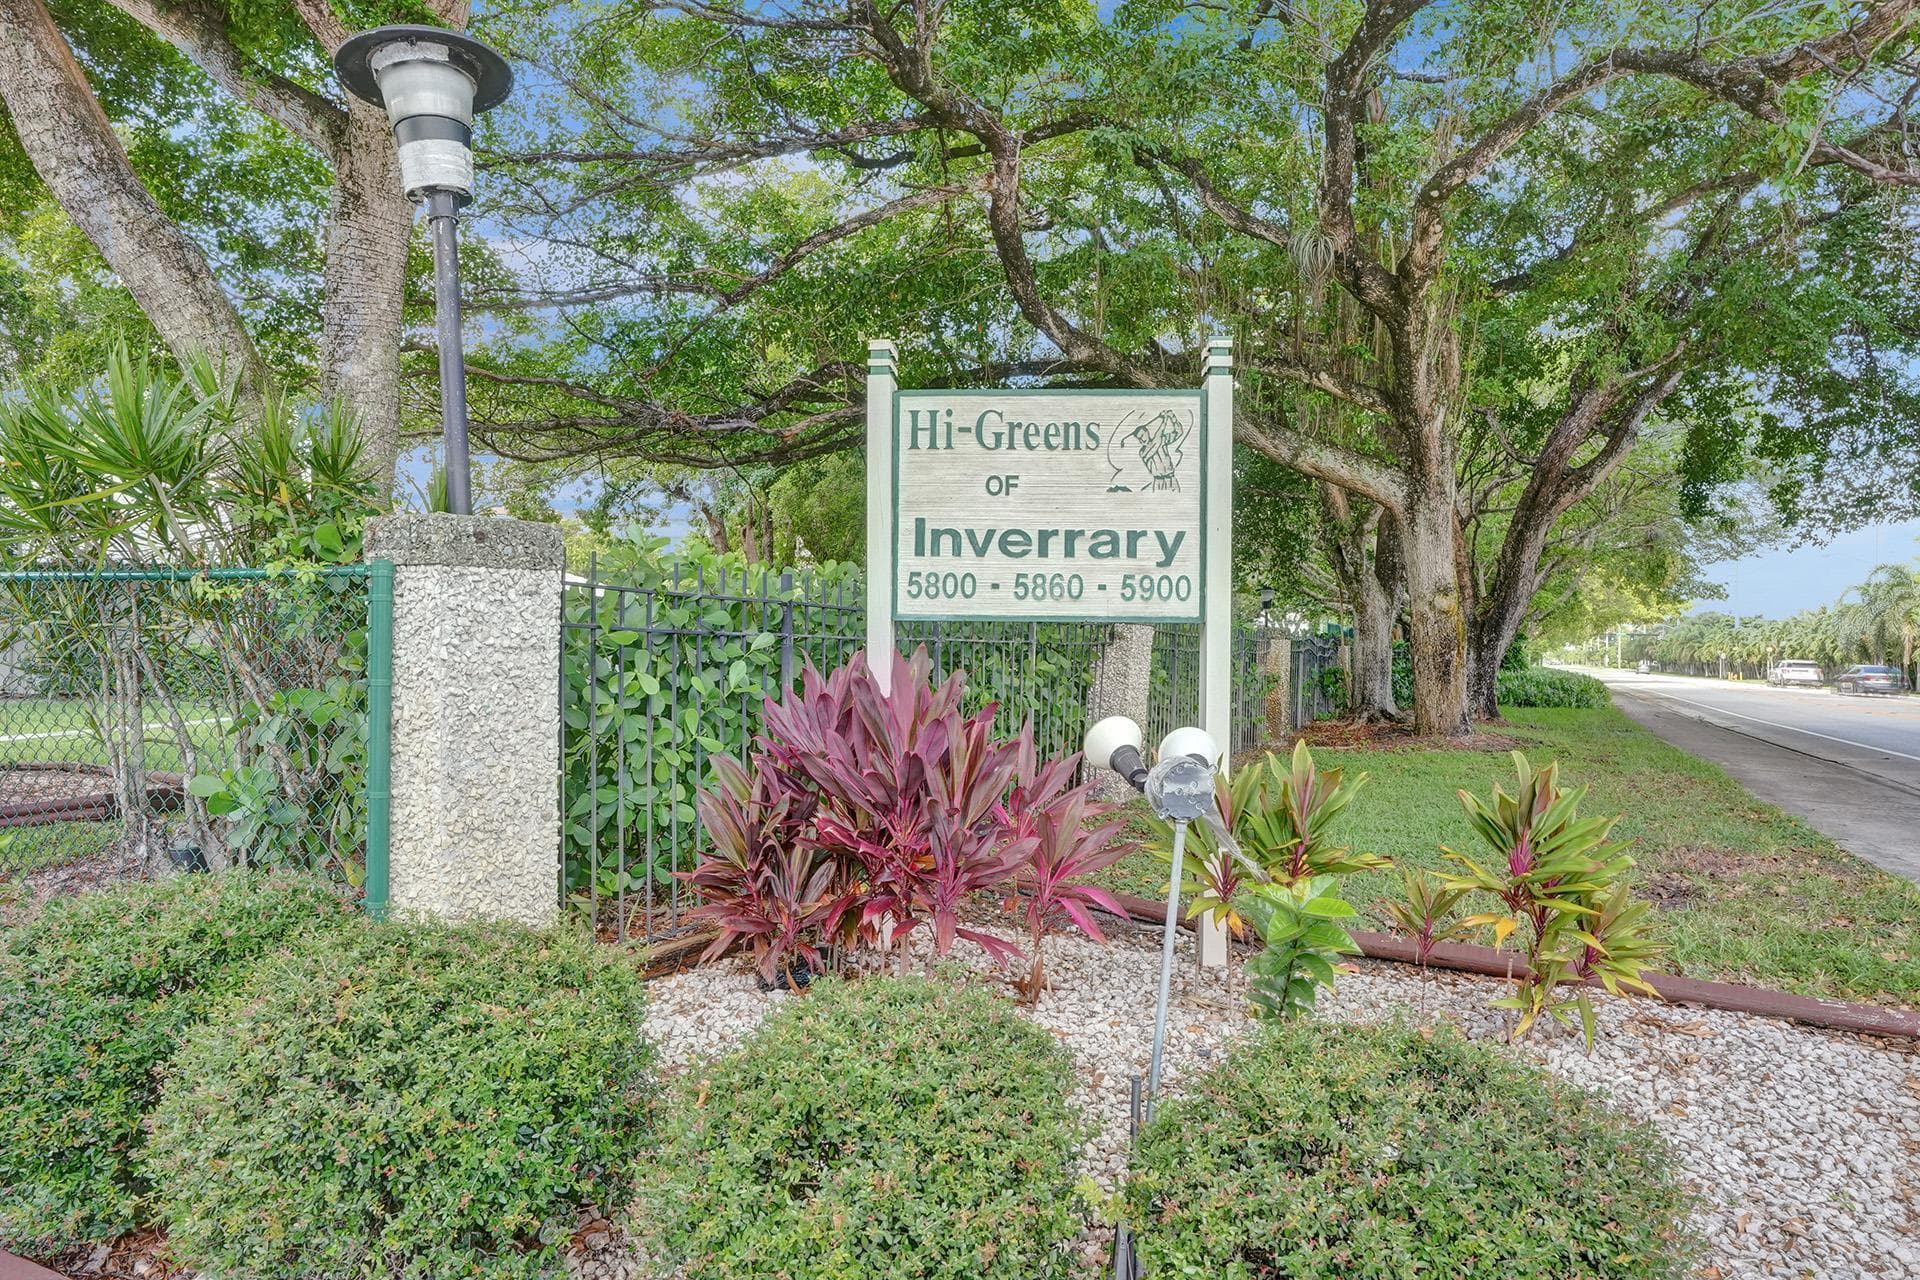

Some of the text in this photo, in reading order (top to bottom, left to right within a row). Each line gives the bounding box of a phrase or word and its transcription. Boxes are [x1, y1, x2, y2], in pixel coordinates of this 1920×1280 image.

[907, 408, 1101, 451] Hi-Greens
[985, 475, 1020, 496] OF
[914, 517, 1187, 568] Inverrary
[907, 571, 977, 600] 5800
[1013, 573, 1084, 601] 5860
[1121, 574, 1192, 602] 5900
